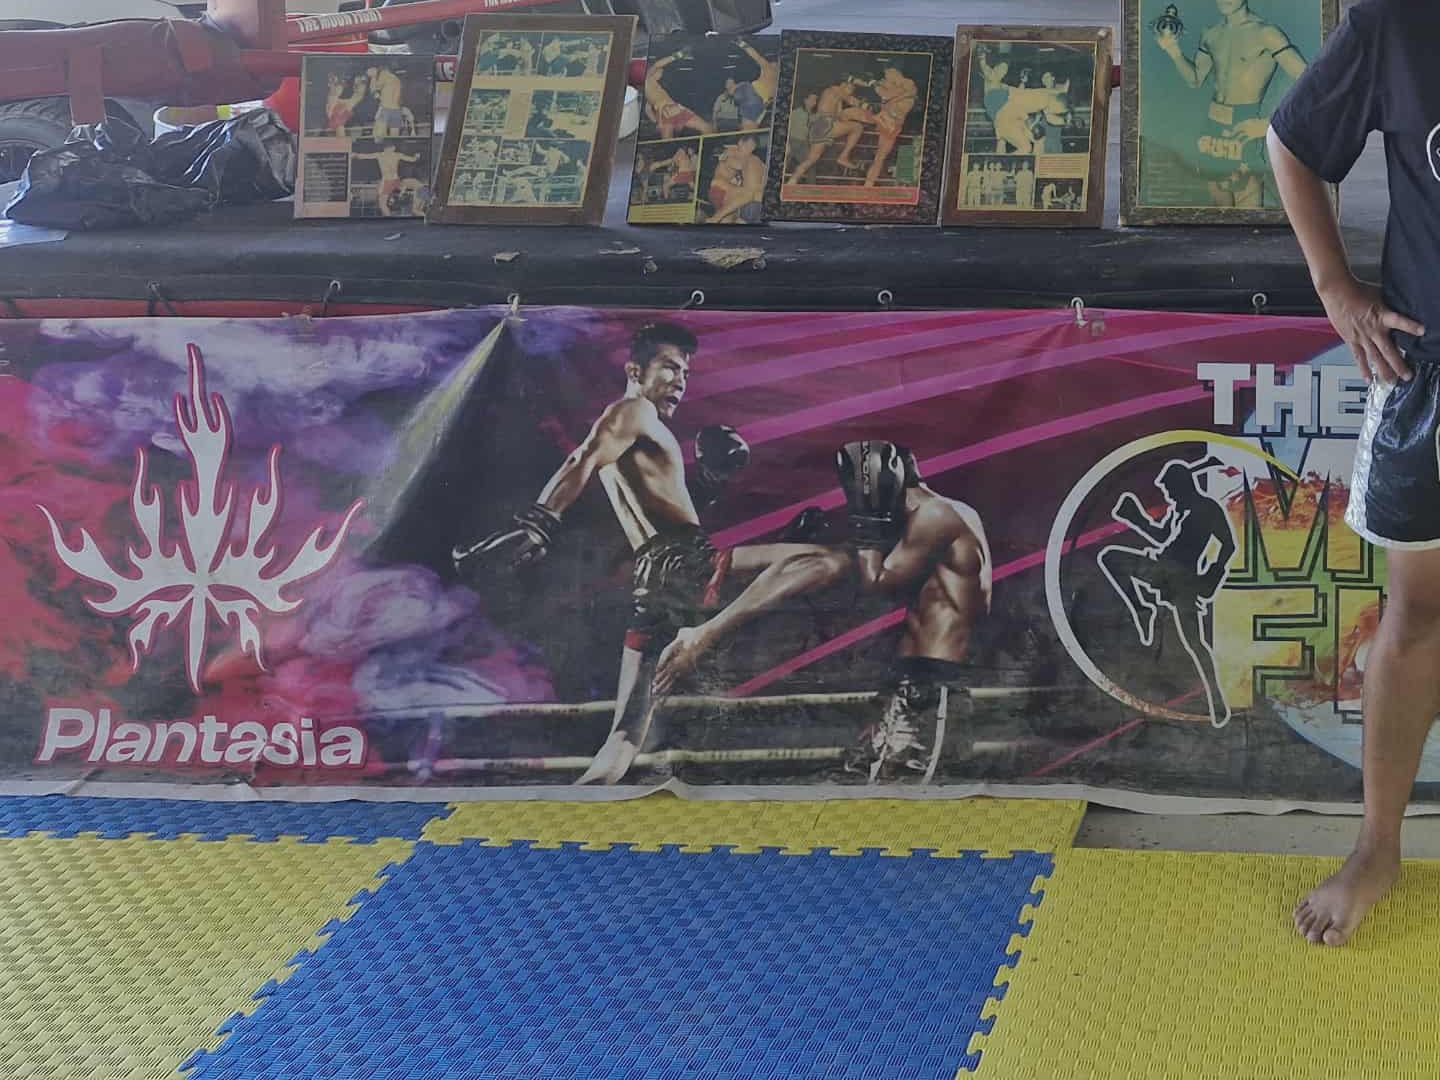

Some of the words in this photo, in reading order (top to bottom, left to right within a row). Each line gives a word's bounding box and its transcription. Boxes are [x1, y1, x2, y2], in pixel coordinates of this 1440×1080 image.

[300, 17, 320, 32] THE
[1197, 362, 1368, 428] THE
[36, 706, 367, 767] Plantasia
